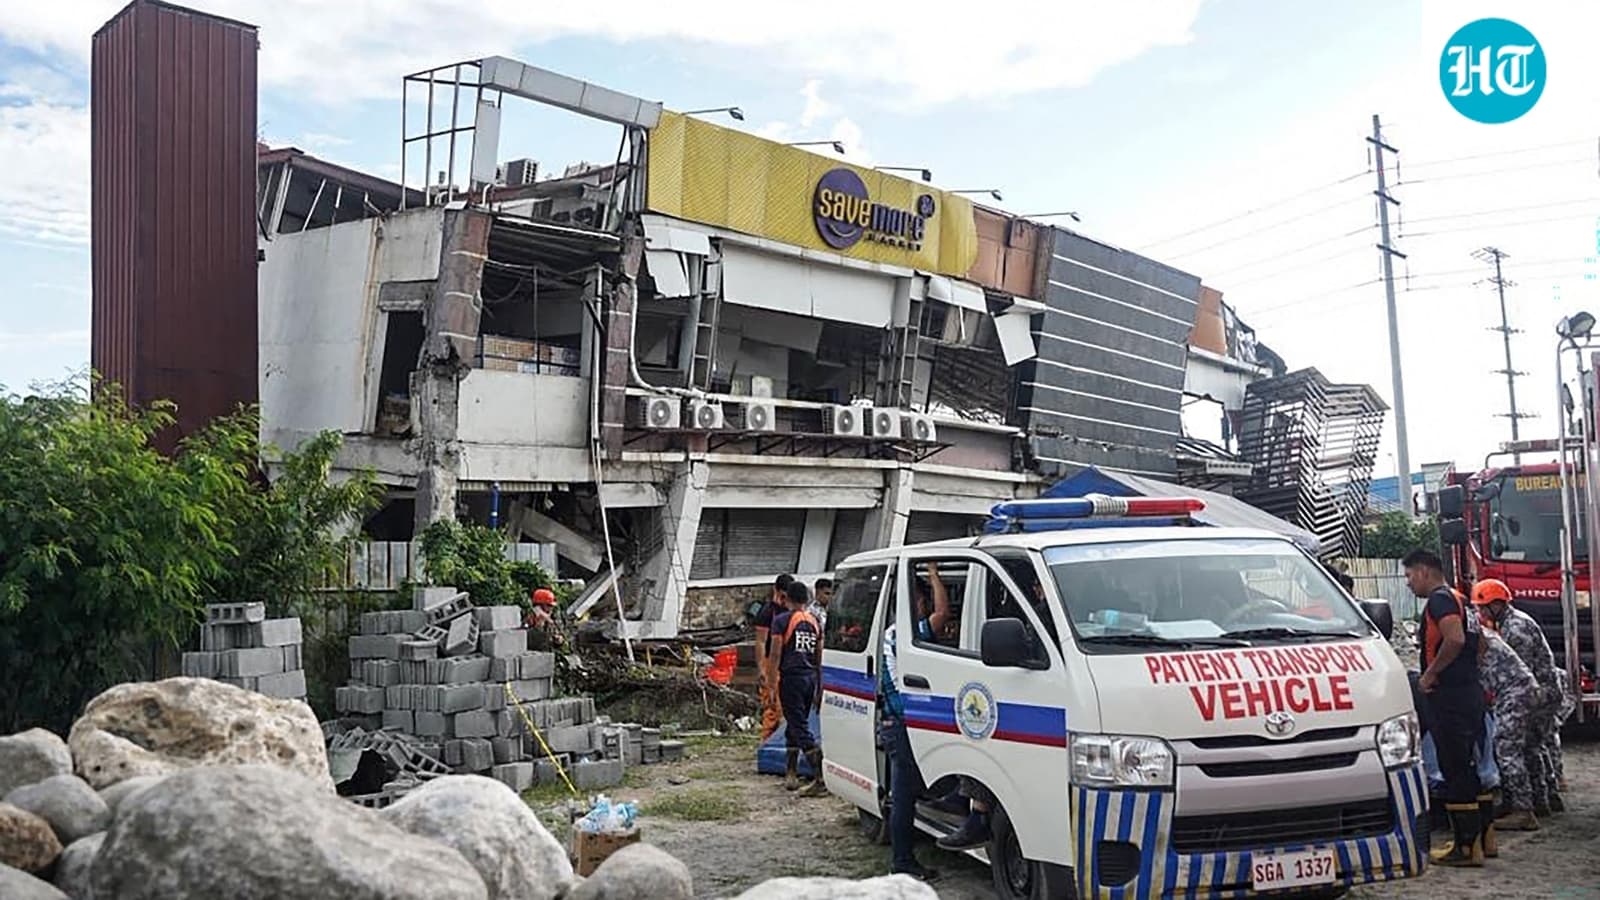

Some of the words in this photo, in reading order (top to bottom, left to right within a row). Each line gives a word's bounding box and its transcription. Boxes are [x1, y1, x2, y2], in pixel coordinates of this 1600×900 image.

[1514, 589, 1560, 597] HINO
[1144, 654, 1243, 684] PATIENT
[1244, 643, 1373, 676] TRANSPORT
[1189, 675, 1354, 721] VEHICLE
[1255, 862, 1285, 883] SGA
[1295, 857, 1332, 879] 1337
